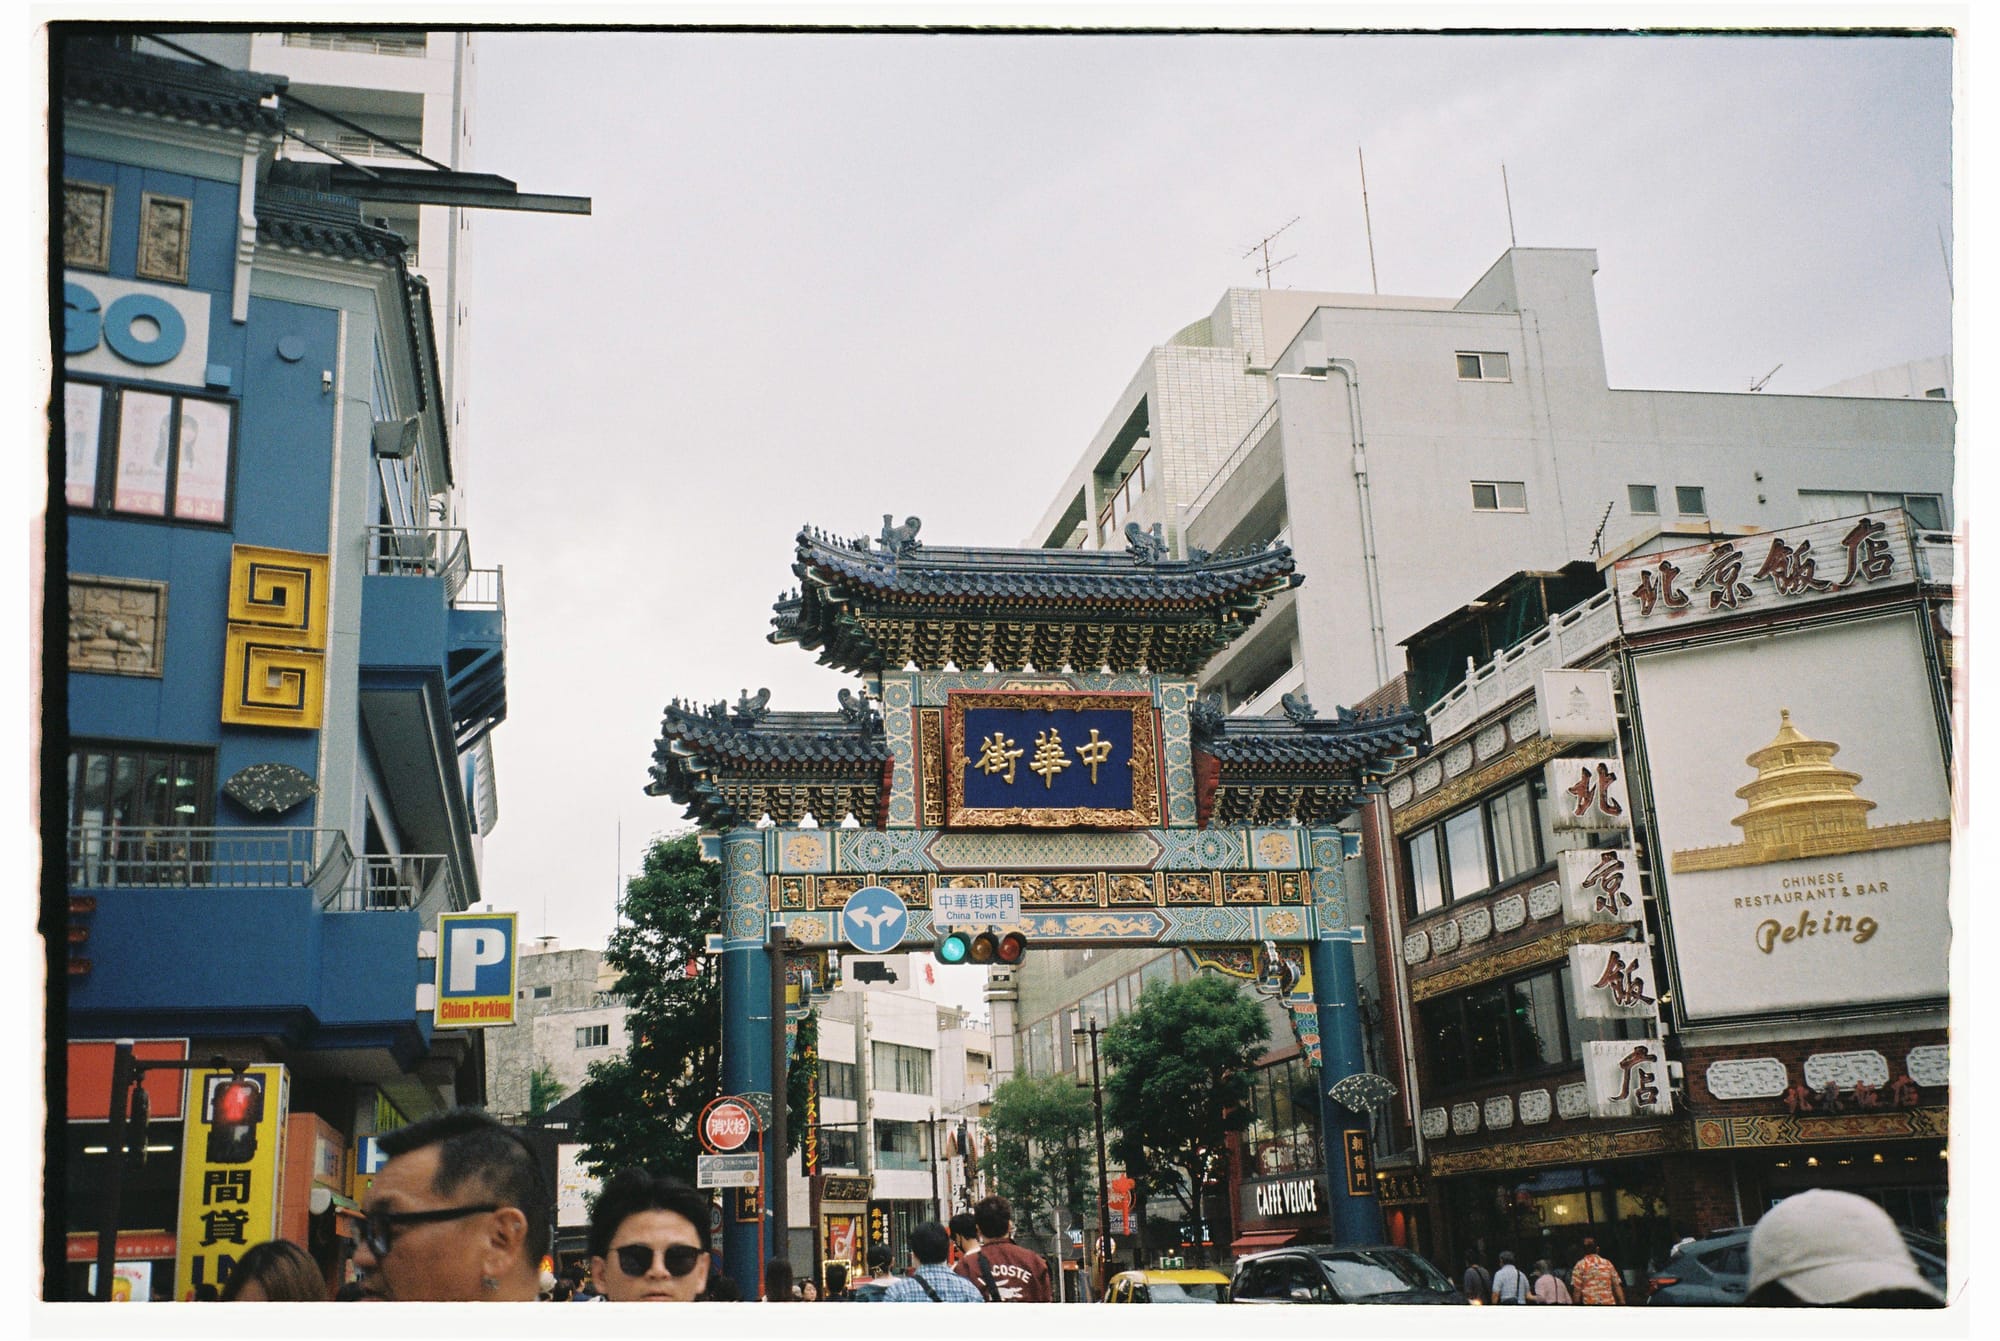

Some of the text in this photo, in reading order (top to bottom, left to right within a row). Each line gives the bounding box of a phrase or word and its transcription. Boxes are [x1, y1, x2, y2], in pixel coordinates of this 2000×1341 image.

[1632, 517, 1896, 617] 北京飯店
[974, 727, 1113, 789] 中華街
[1782, 872, 1845, 889] CHINESE
[938, 893, 1014, 909] 中華街東門
[1734, 881, 1889, 908] RESTAURANT & BAR
[946, 911, 970, 920] China
[974, 911, 996, 920] Town
[1567, 762, 1658, 1108] 北京飯店
[1756, 910, 1879, 954] Peking
[450, 928, 506, 991] P
[441, 1000, 511, 1021] China Parking
[711, 1119, 746, 1136] 消火栓
[1283, 1179, 1317, 1214] VELOCE
[991, 1264, 1032, 1283] COSTE
